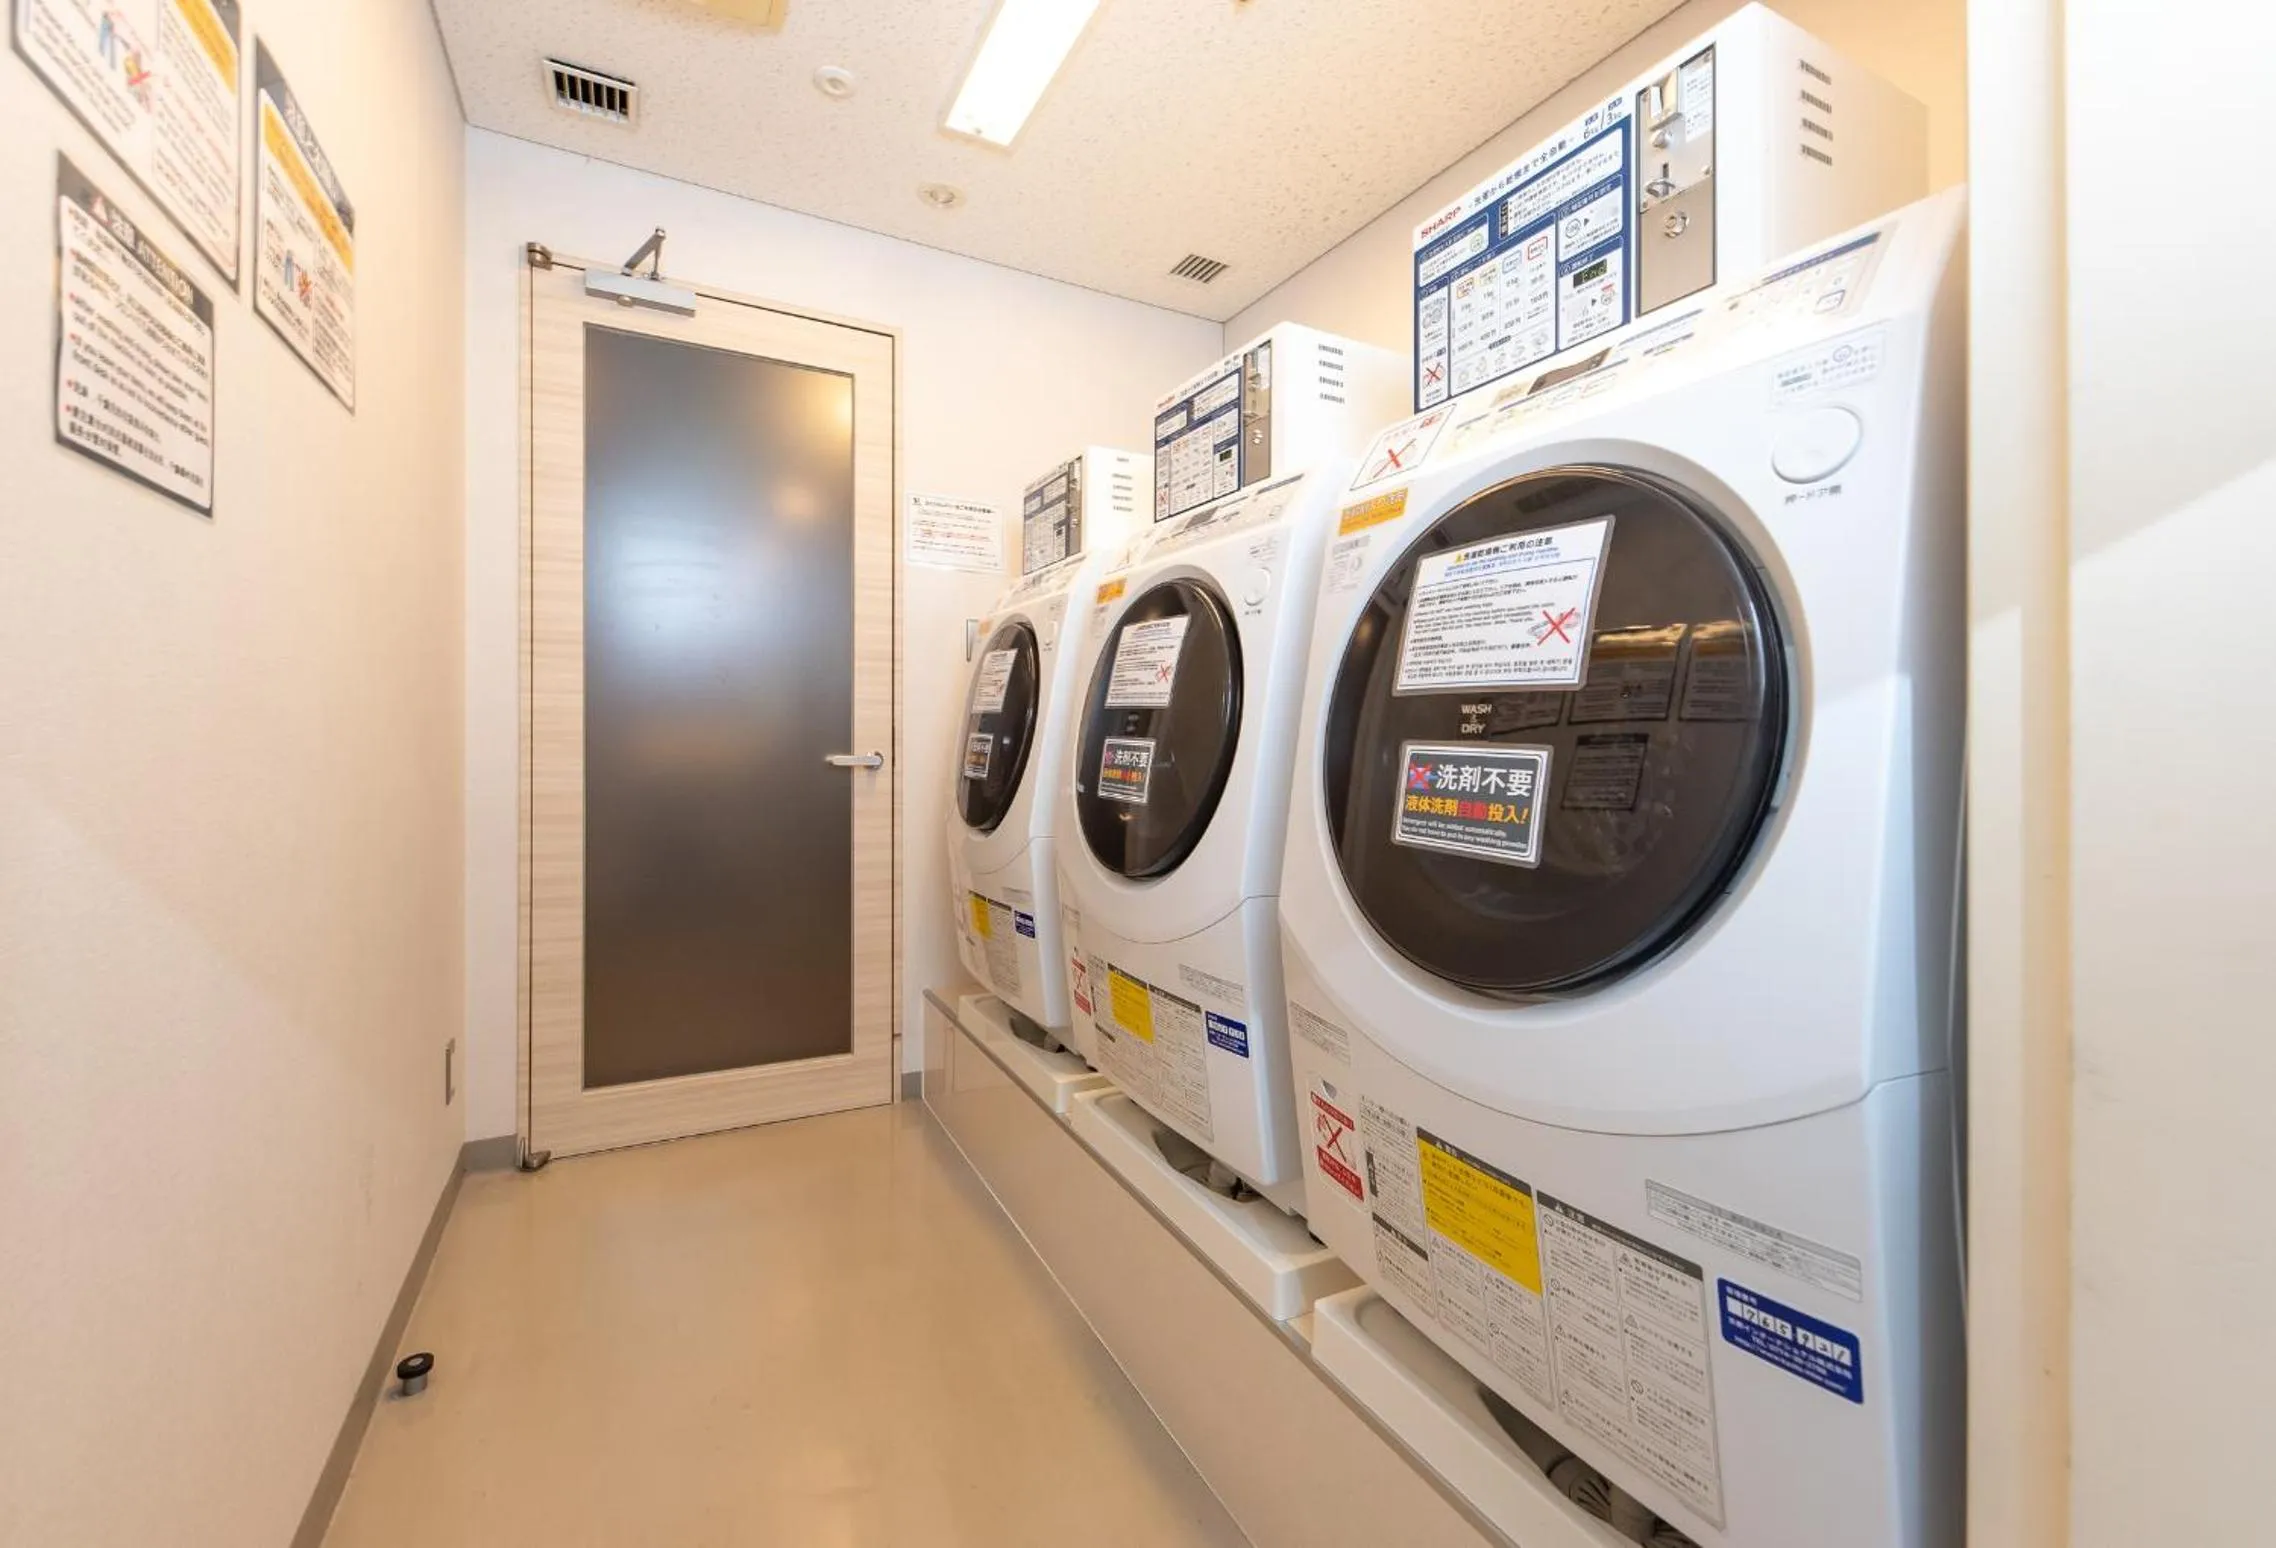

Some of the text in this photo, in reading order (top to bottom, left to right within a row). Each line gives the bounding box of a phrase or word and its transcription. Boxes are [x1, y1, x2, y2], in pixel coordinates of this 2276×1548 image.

[1421, 206, 1461, 238] SHARP
[1460, 704, 1493, 714] WASH
[1461, 723, 1486, 734] DRY
[1435, 763, 1534, 797] 洗剤不要
